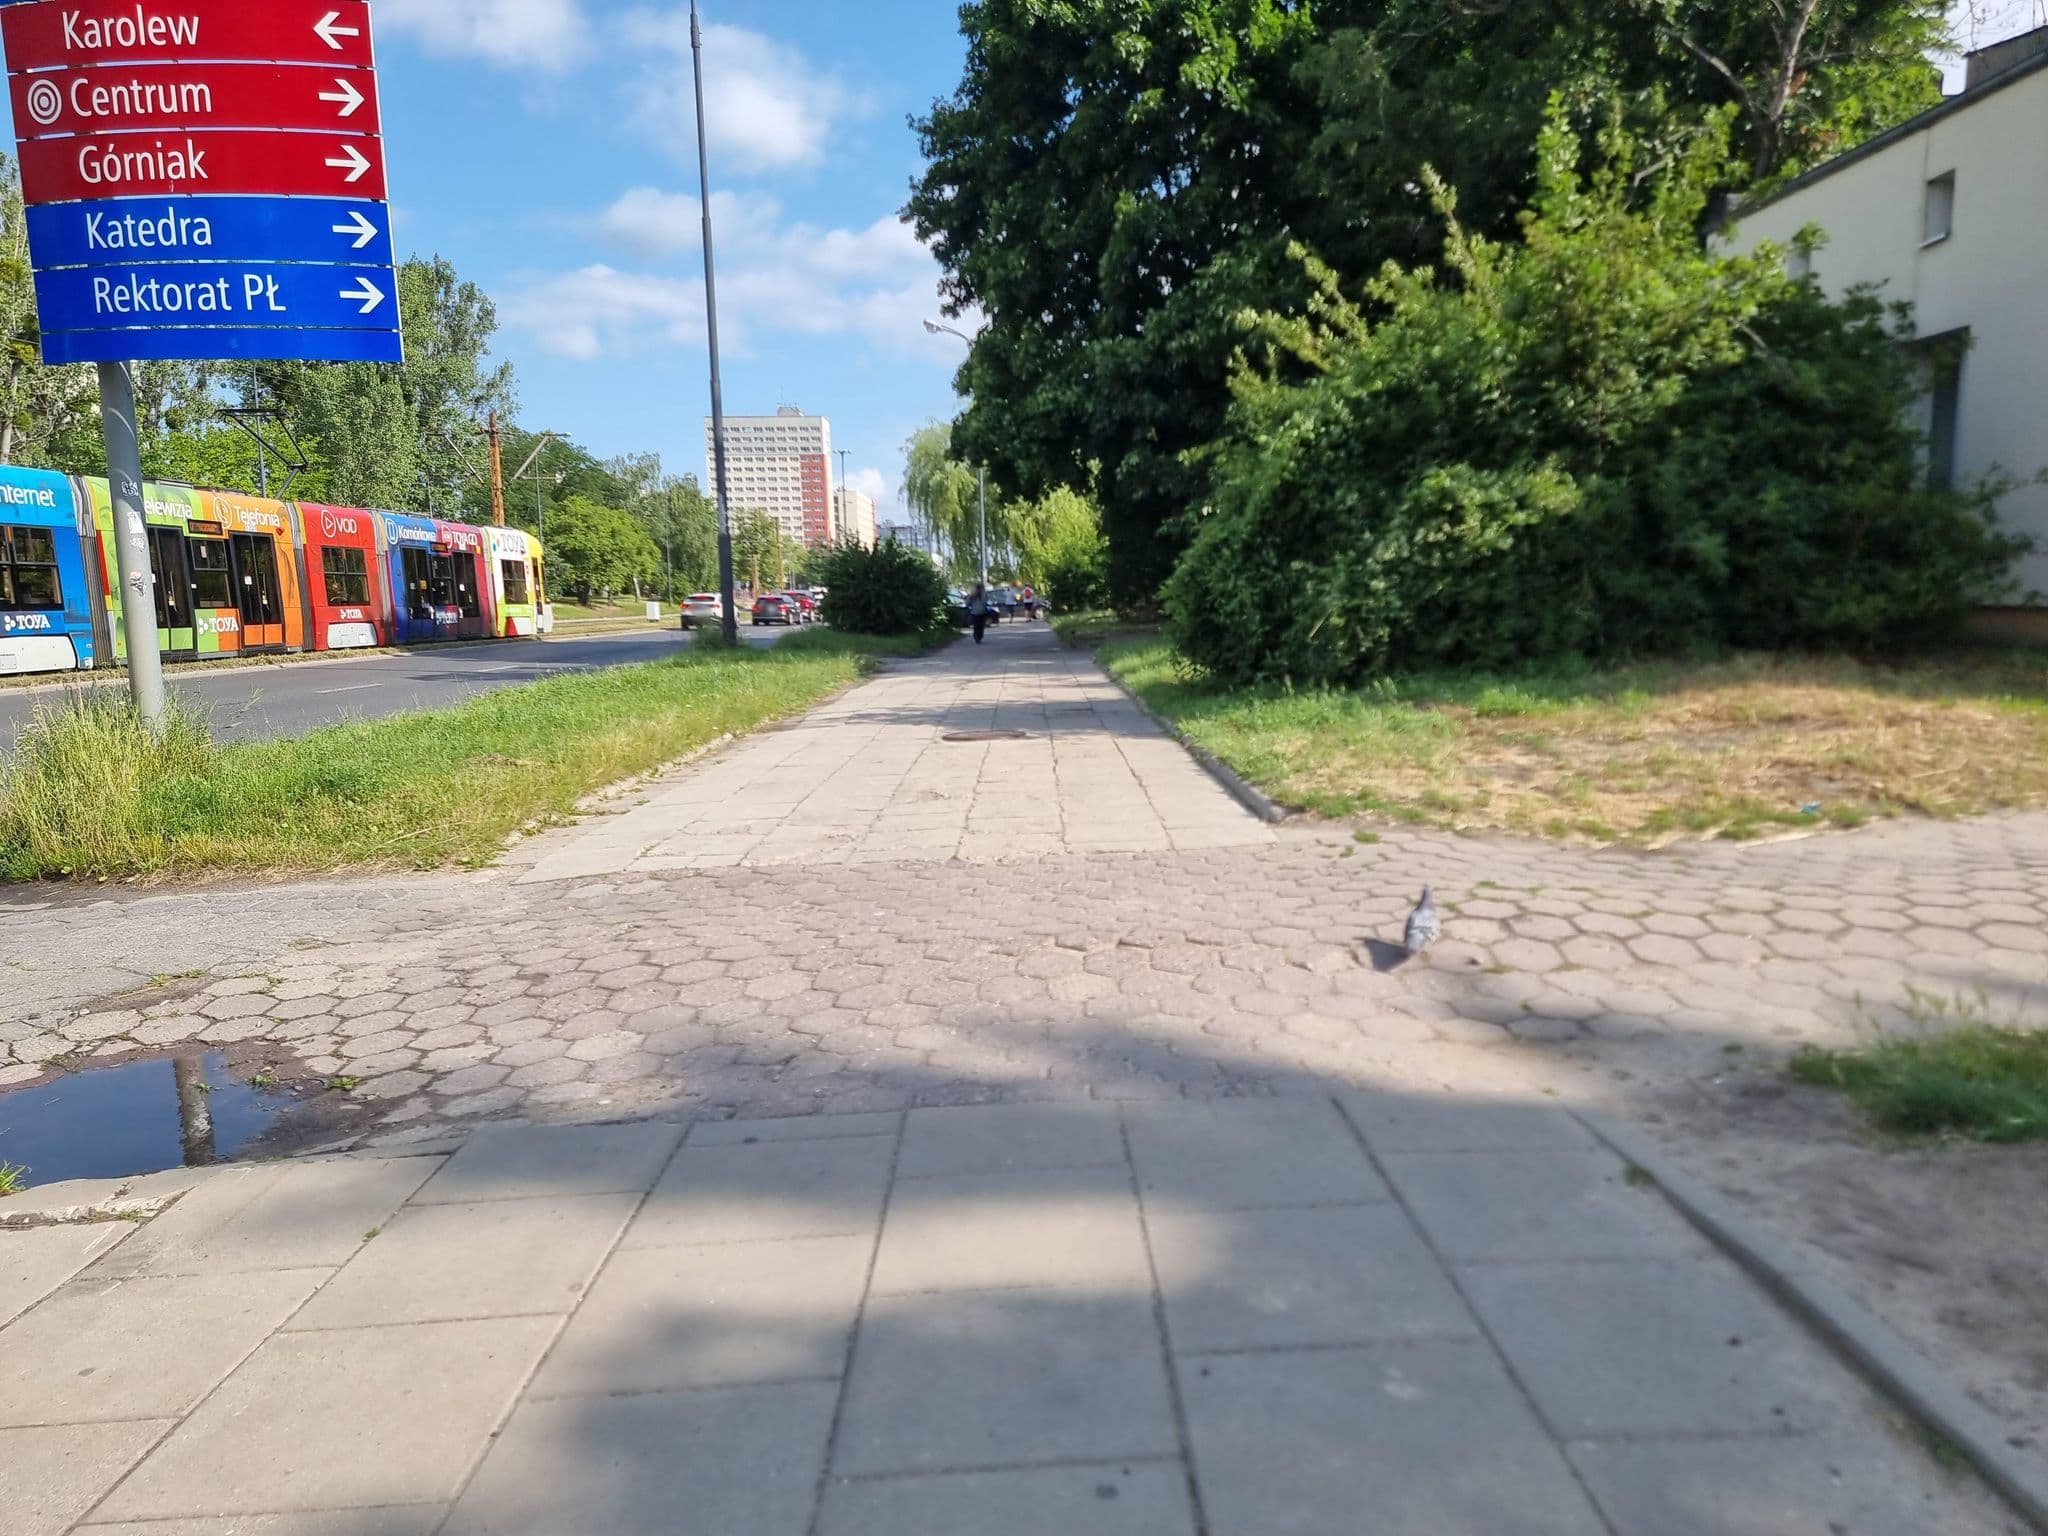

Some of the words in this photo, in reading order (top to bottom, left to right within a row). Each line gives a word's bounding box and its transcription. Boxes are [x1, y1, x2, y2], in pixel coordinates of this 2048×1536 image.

[62, 4, 200, 50] Karolew
[70, 78, 212, 117] Centrum
[78, 138, 209, 184] Górniak
[86, 206, 212, 249] Katedra
[93, 273, 231, 313] Rektorat
[243, 273, 287, 312] PŁ
[0, 484, 57, 508] nternet
[144, 498, 193, 522] elewizja
[233, 506, 281, 527] Telefonia
[336, 518, 357, 534] VOD
[500, 533, 526, 553] TOYA
[16, 614, 51, 629] TOYA
[209, 616, 239, 633] TOYA
